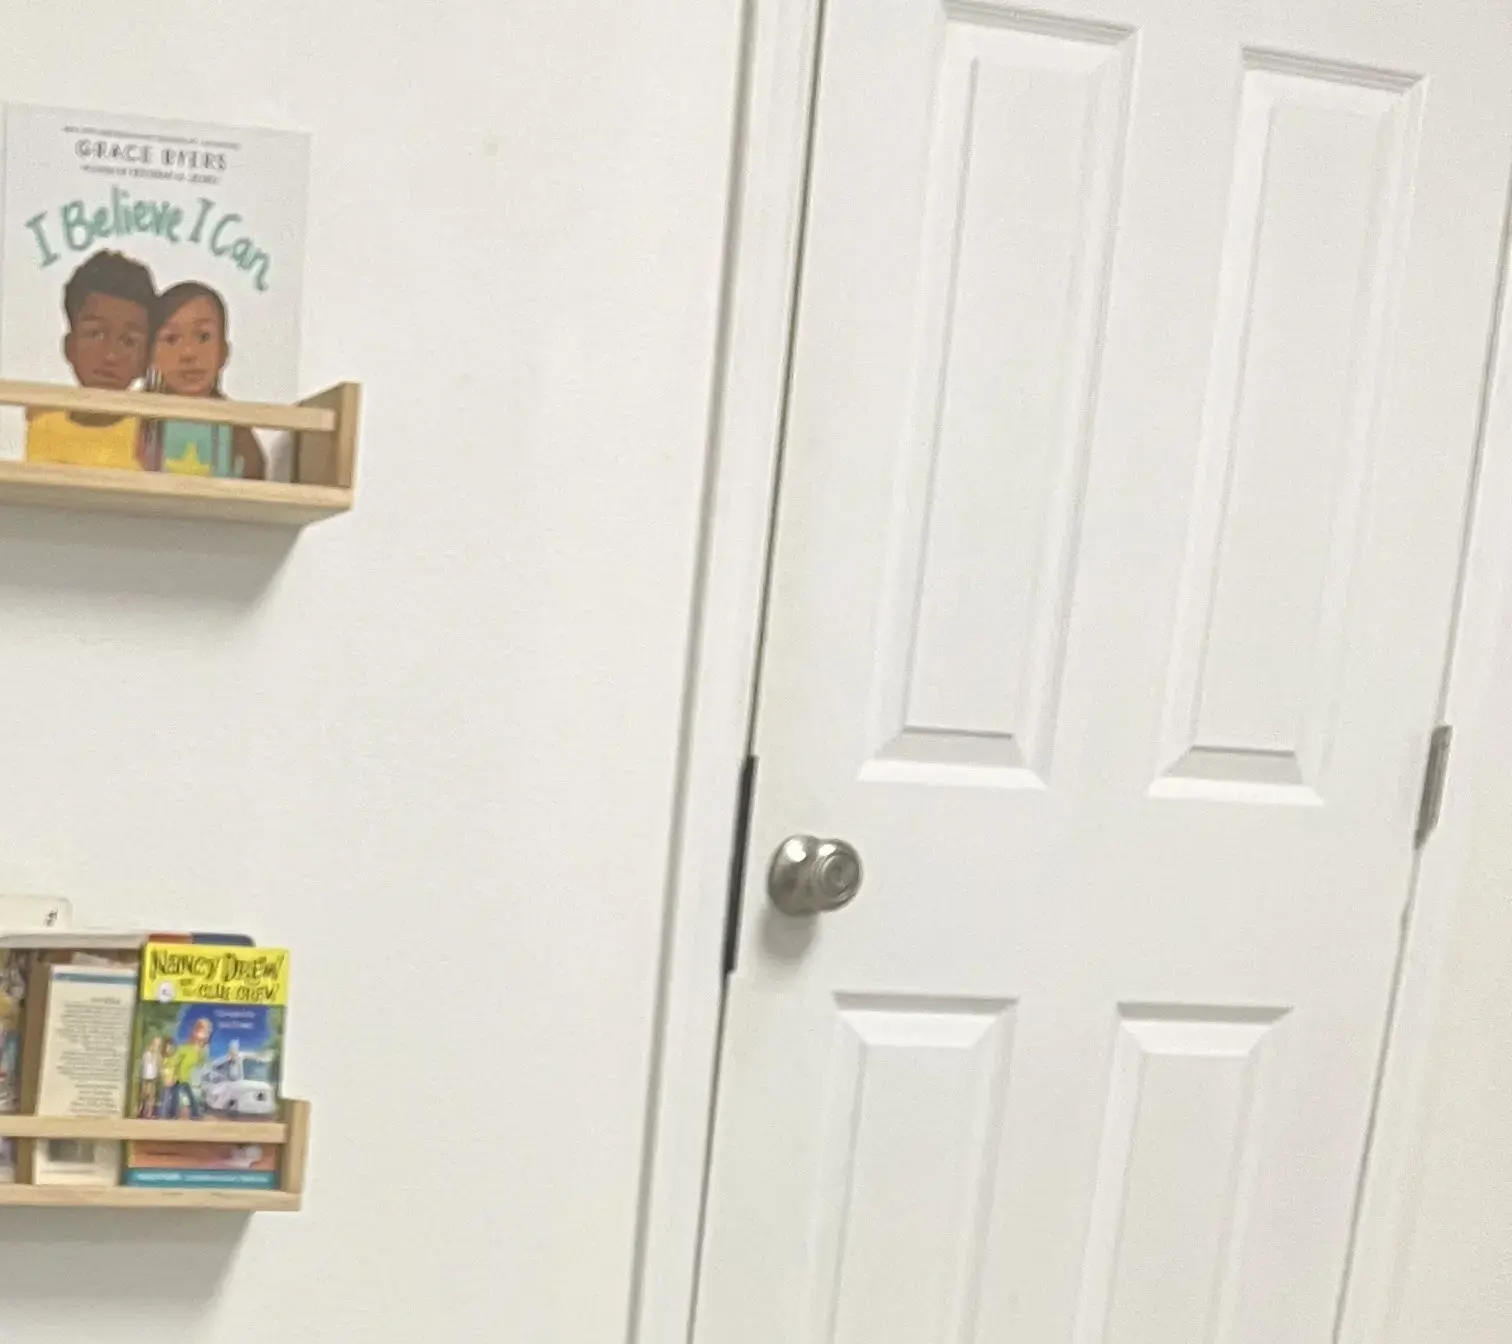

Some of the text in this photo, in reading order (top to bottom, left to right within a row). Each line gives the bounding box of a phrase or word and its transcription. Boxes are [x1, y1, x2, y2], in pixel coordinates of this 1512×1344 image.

[74, 138, 154, 165] GRACE
[25, 184, 274, 293] I Believe I Can
